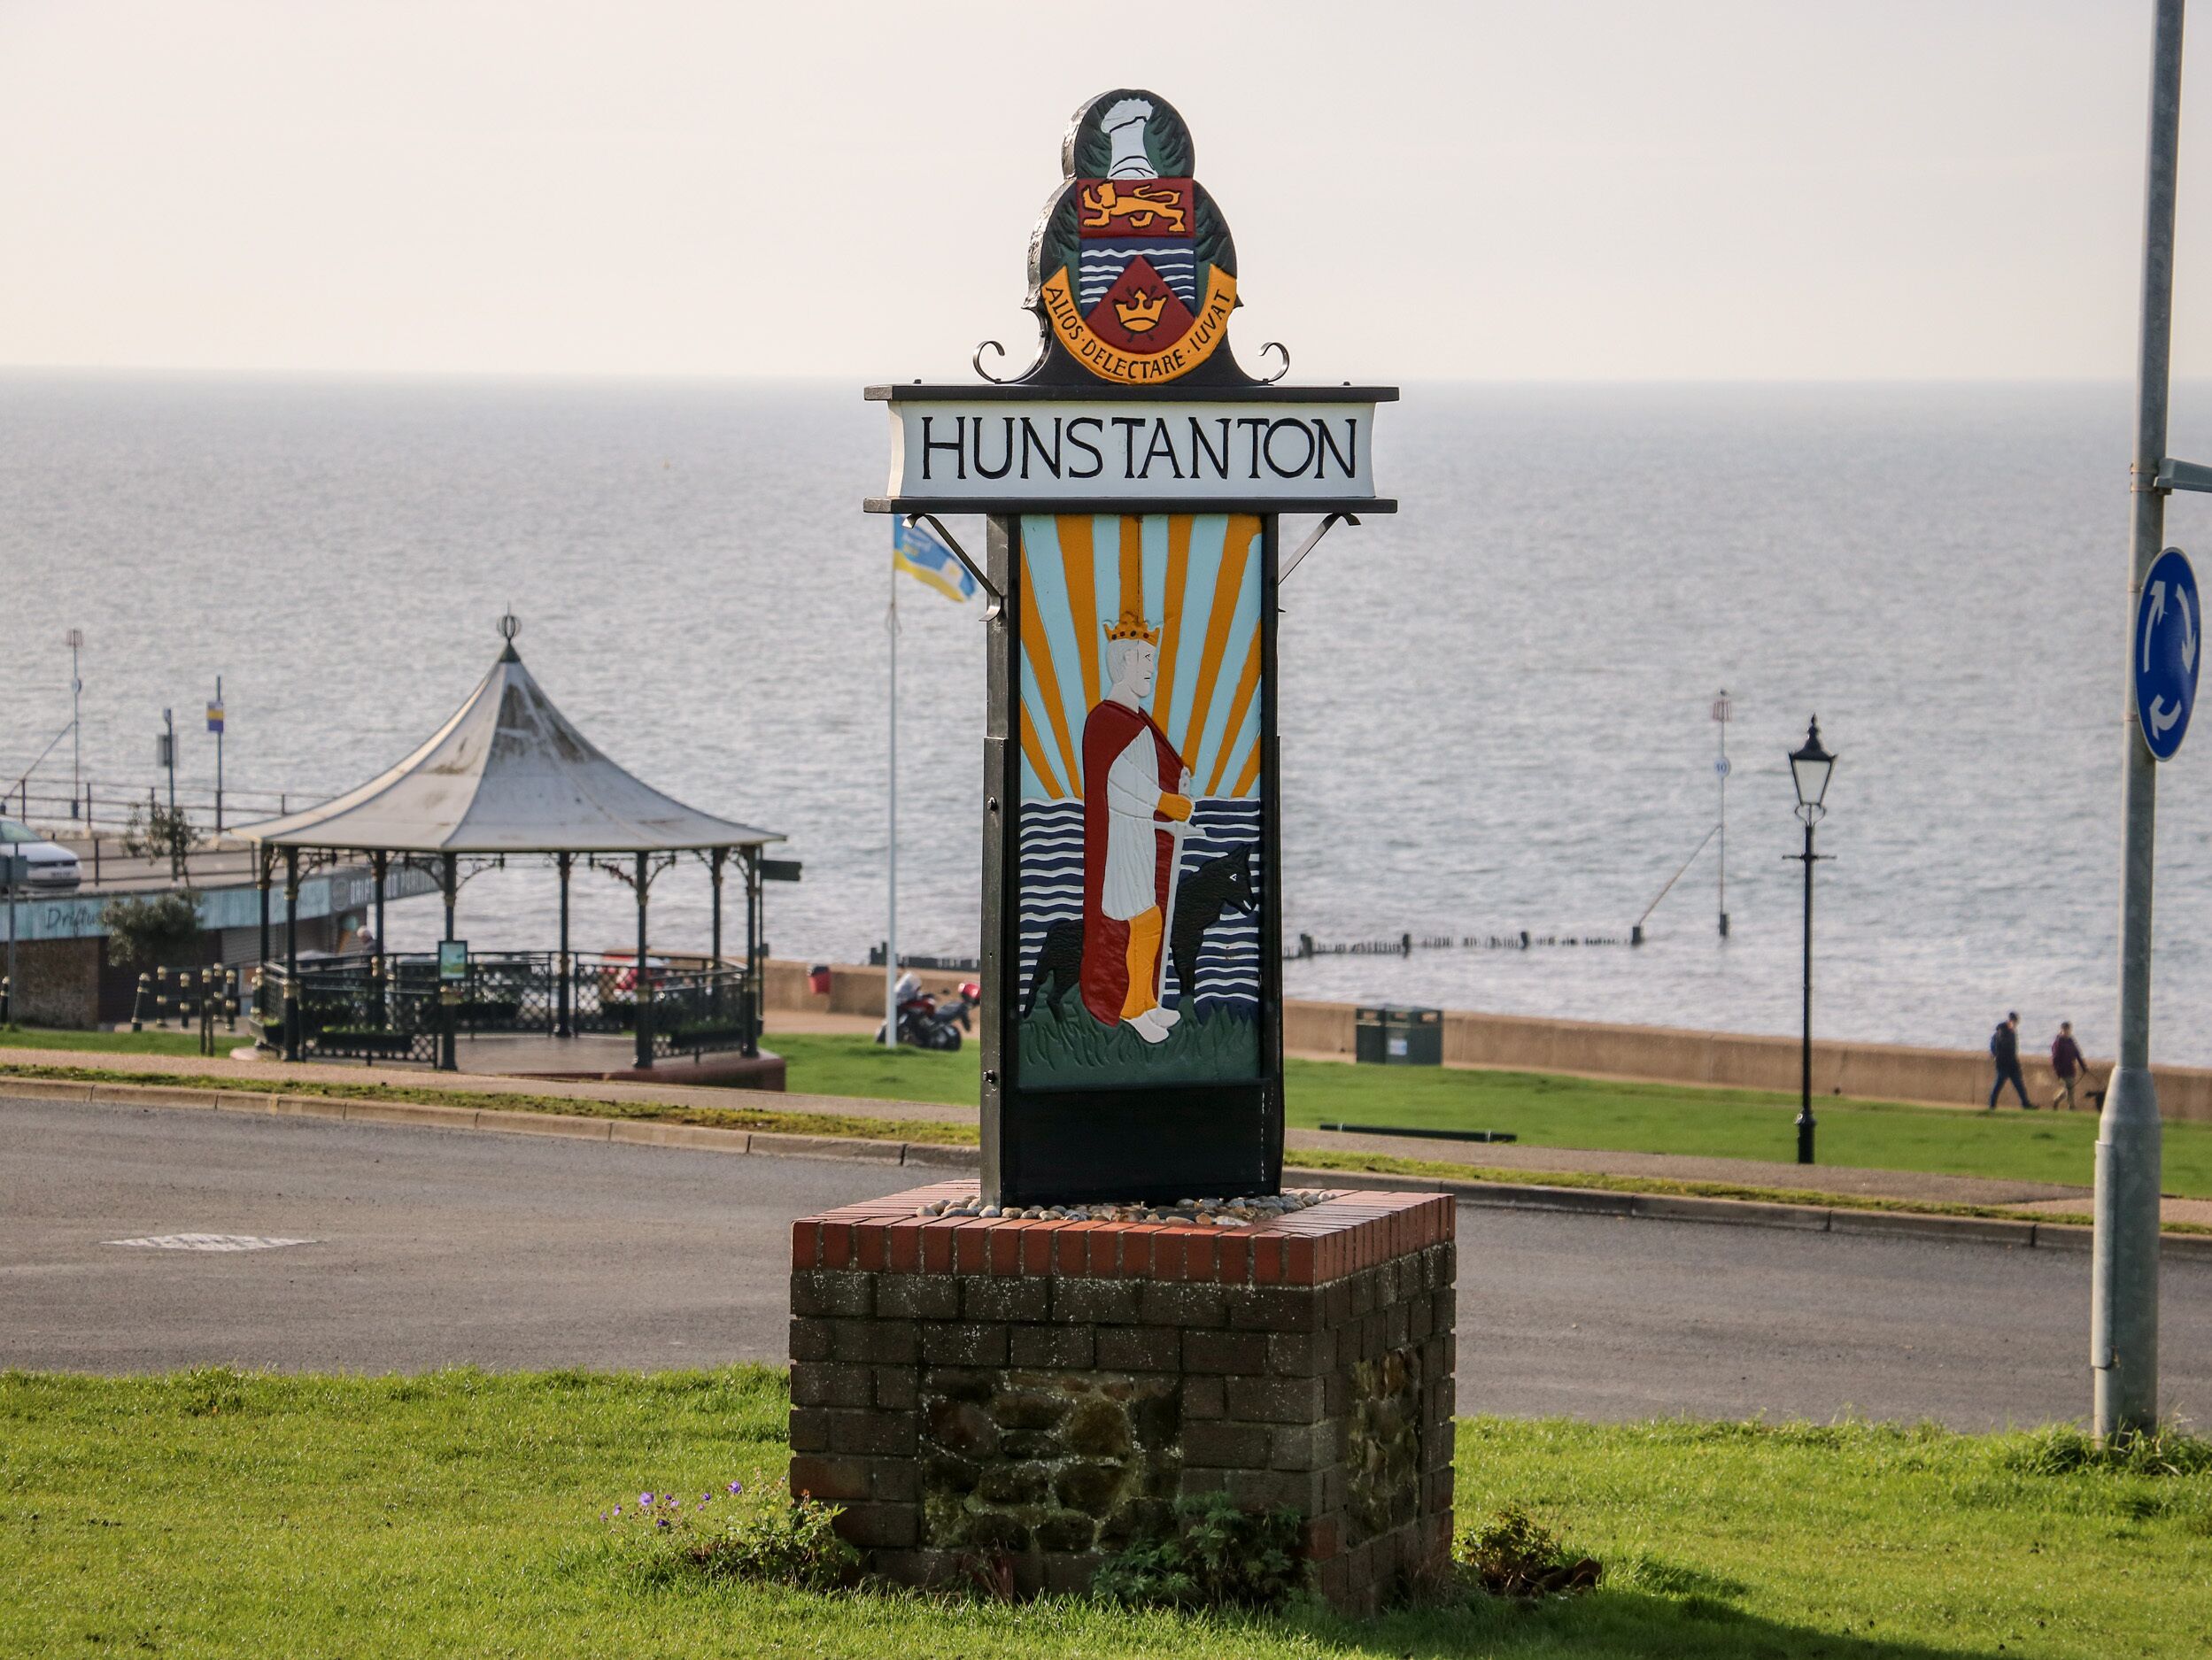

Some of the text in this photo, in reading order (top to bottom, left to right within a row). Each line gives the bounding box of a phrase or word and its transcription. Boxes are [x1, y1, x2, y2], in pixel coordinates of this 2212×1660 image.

[1045, 287, 1231, 379] ALIOS DELECTARE IUVAT
[922, 416, 1358, 480] HUNSTANTON
